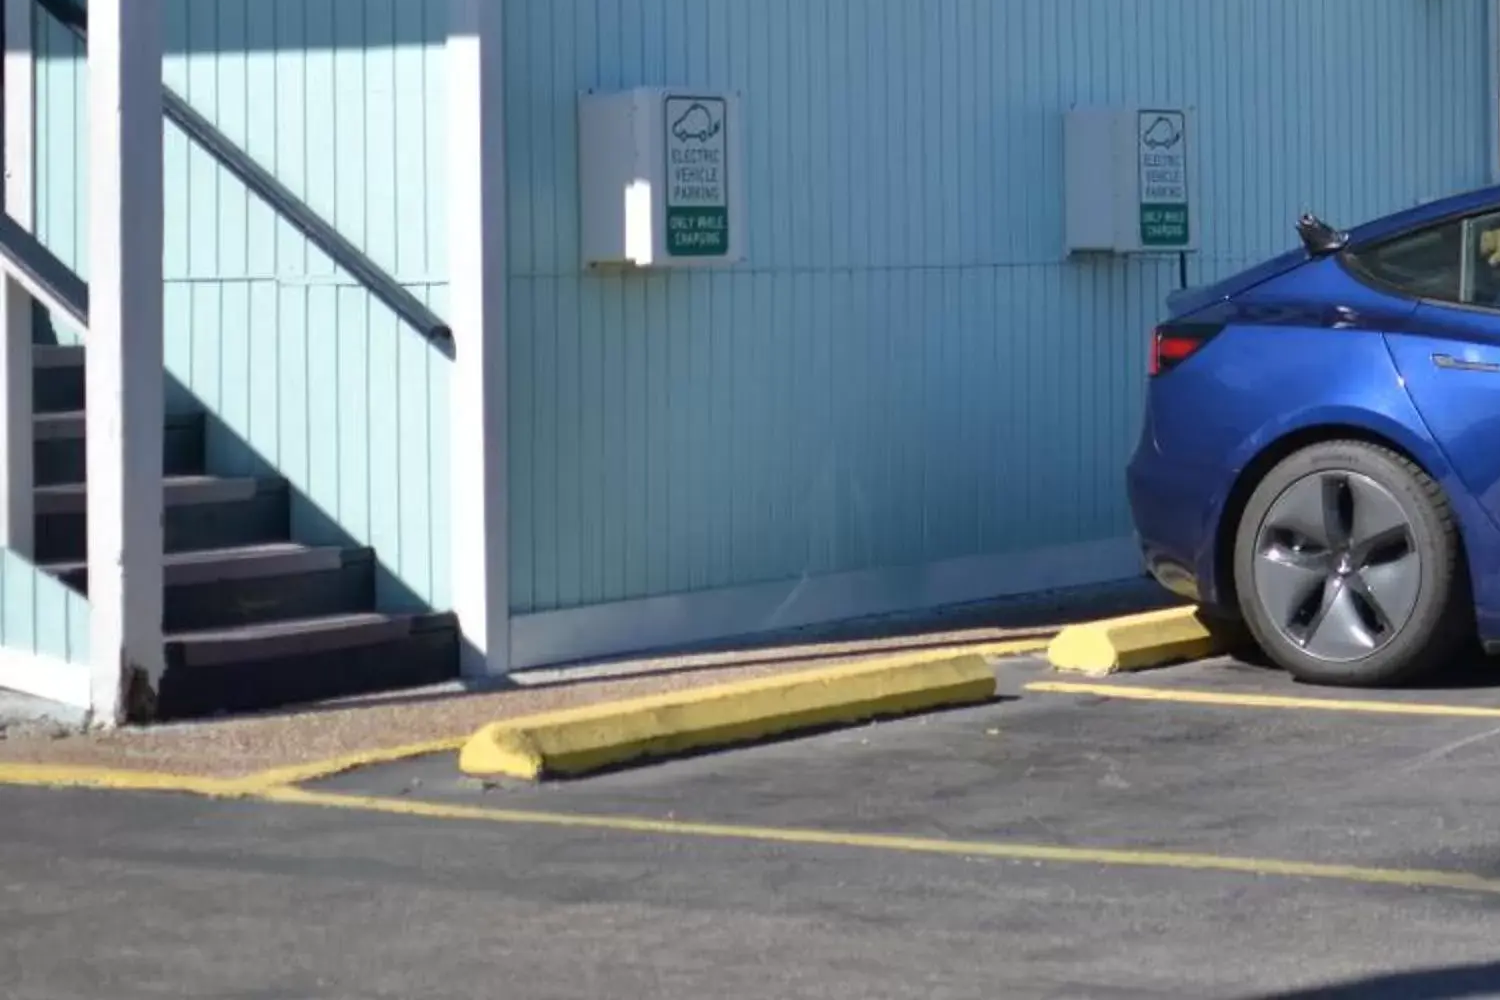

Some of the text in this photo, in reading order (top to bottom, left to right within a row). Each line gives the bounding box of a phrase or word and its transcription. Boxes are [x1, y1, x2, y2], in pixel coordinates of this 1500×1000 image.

[671, 148, 720, 164] ELECTRIC
[675, 166, 718, 182] VEHICLE
[674, 185, 719, 200] PARKING
